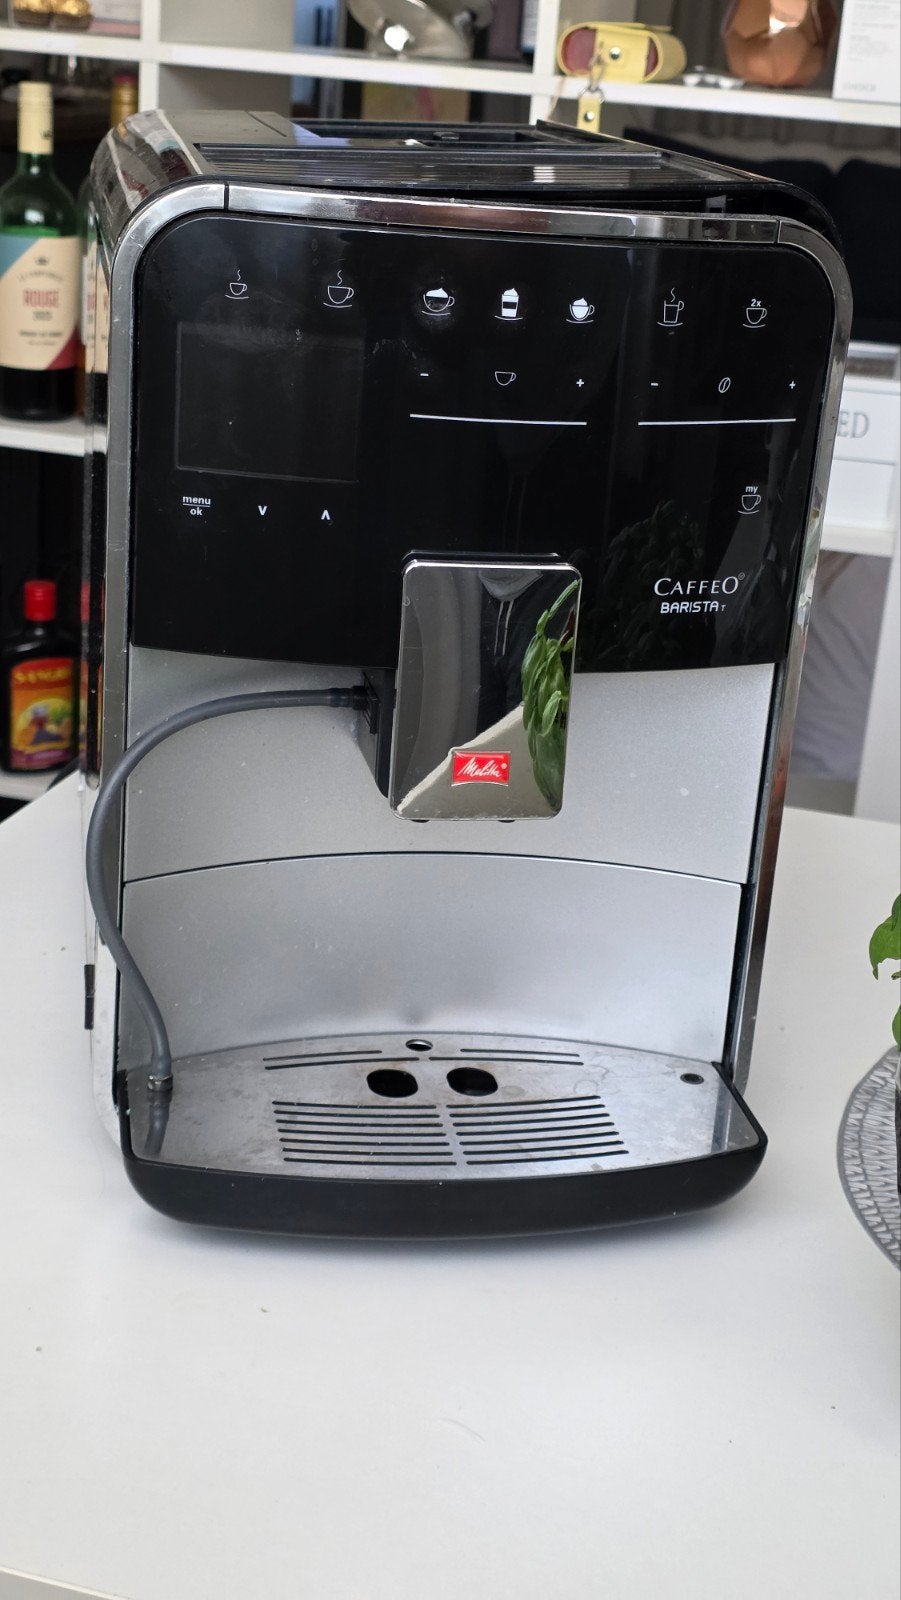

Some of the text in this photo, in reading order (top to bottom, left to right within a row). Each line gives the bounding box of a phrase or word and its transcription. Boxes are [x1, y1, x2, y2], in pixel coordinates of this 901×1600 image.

[23, 289, 59, 308] ROUGE
[750, 298, 762, 307] 2x
[745, 486, 759, 494] my
[182, 496, 211, 505] menu
[190, 507, 203, 516] ok
[660, 601, 719, 614] BARISTA
[457, 756, 502, 777] Melitta
